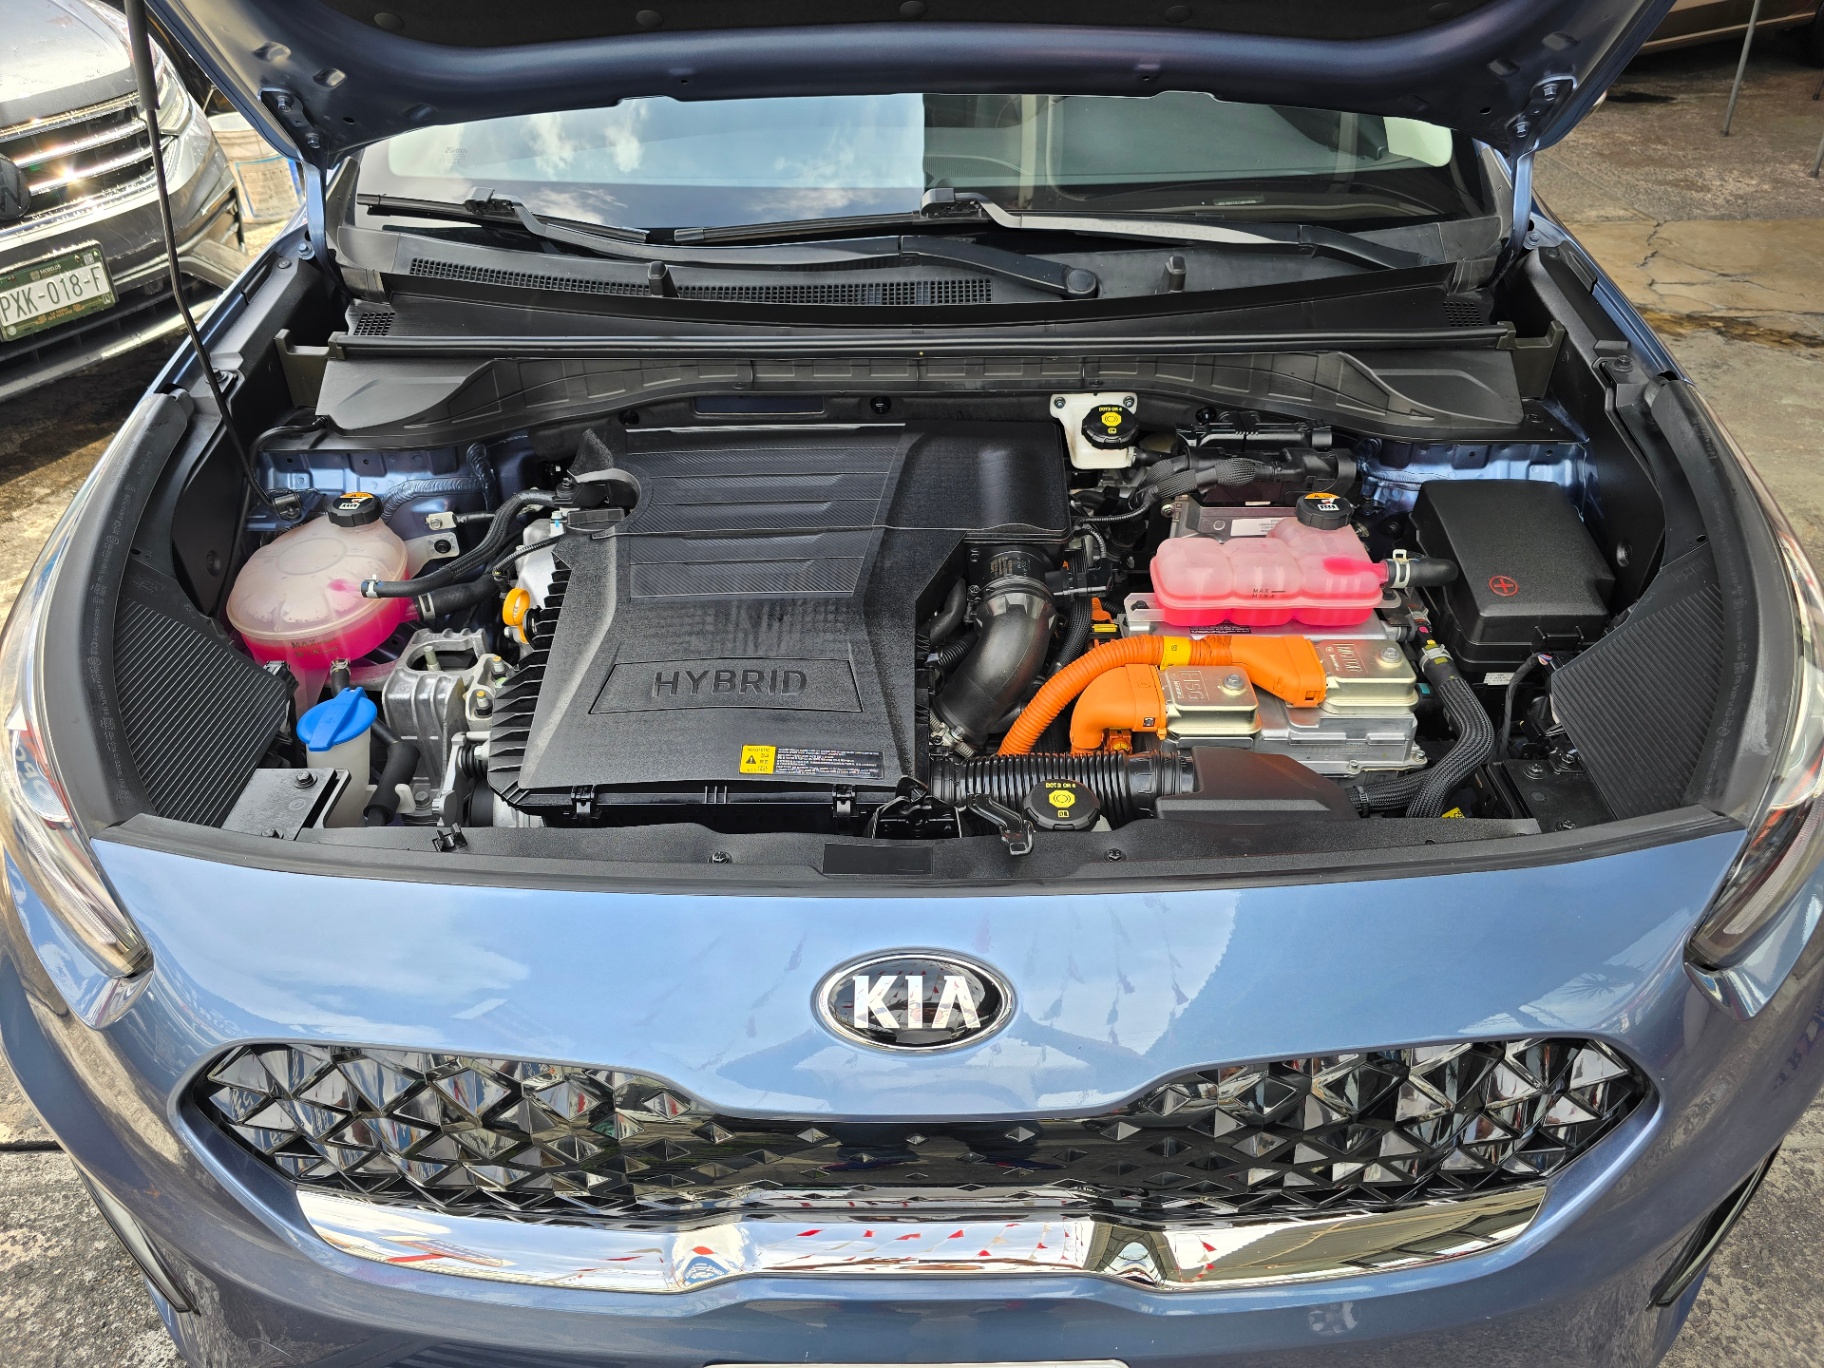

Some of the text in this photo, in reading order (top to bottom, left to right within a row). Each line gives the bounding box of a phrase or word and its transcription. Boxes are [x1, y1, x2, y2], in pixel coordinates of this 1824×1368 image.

[0, 265, 101, 322] PXK-018-F
[652, 669, 807, 697] HYBRID
[852, 975, 981, 1029] KIA
